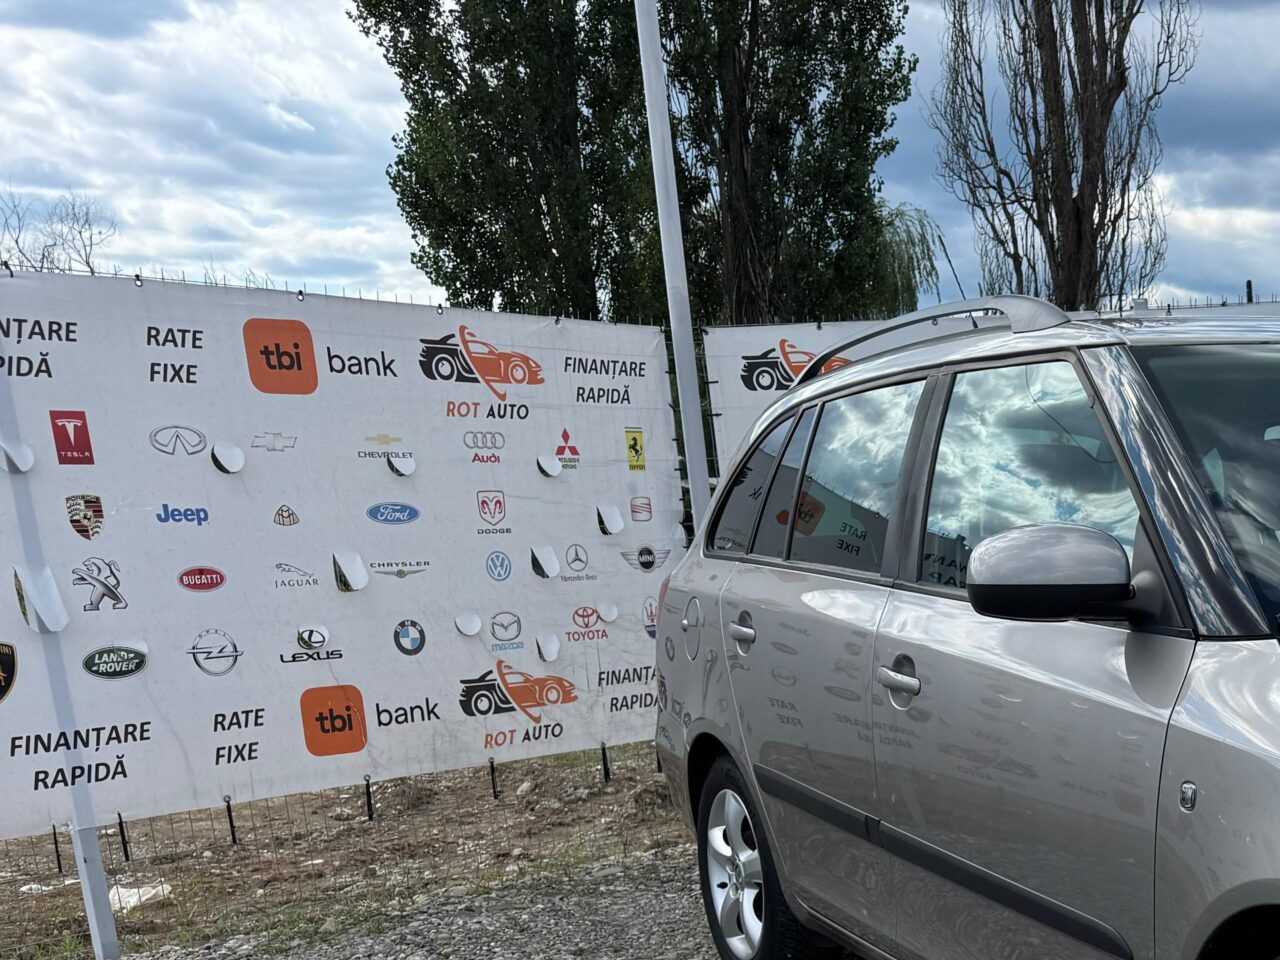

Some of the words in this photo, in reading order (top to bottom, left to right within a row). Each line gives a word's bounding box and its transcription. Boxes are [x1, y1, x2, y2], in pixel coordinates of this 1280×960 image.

[147, 326, 203, 349] RATE
[260, 343, 303, 371] tbi
[327, 347, 398, 378] bank
[150, 362, 198, 384] FIXE
[564, 357, 646, 380] FINANȚARE
[576, 385, 631, 405] RAPIDĂ
[446, 401, 480, 418] ROT
[486, 403, 529, 420] AUTO
[358, 451, 413, 459] CHEVROLET
[156, 504, 209, 526] Jeep
[376, 507, 410, 521] Ford
[370, 560, 430, 568] CHRYSLER
[183, 574, 221, 585] BUGATTI
[275, 578, 319, 589] JAGUAR
[566, 629, 609, 642] TOYOTA
[94, 652, 128, 664] LAND
[99, 660, 137, 673] ROVER
[280, 649, 343, 664] LEXUS
[213, 708, 265, 732] RATE
[315, 705, 353, 734] tbi
[375, 697, 441, 727] bank
[10, 721, 151, 757] FINANȚARE
[484, 729, 517, 749] ROT
[522, 723, 563, 743] AUTO
[215, 742, 259, 765] FIXE
[33, 754, 128, 791] RAPIDĂ
